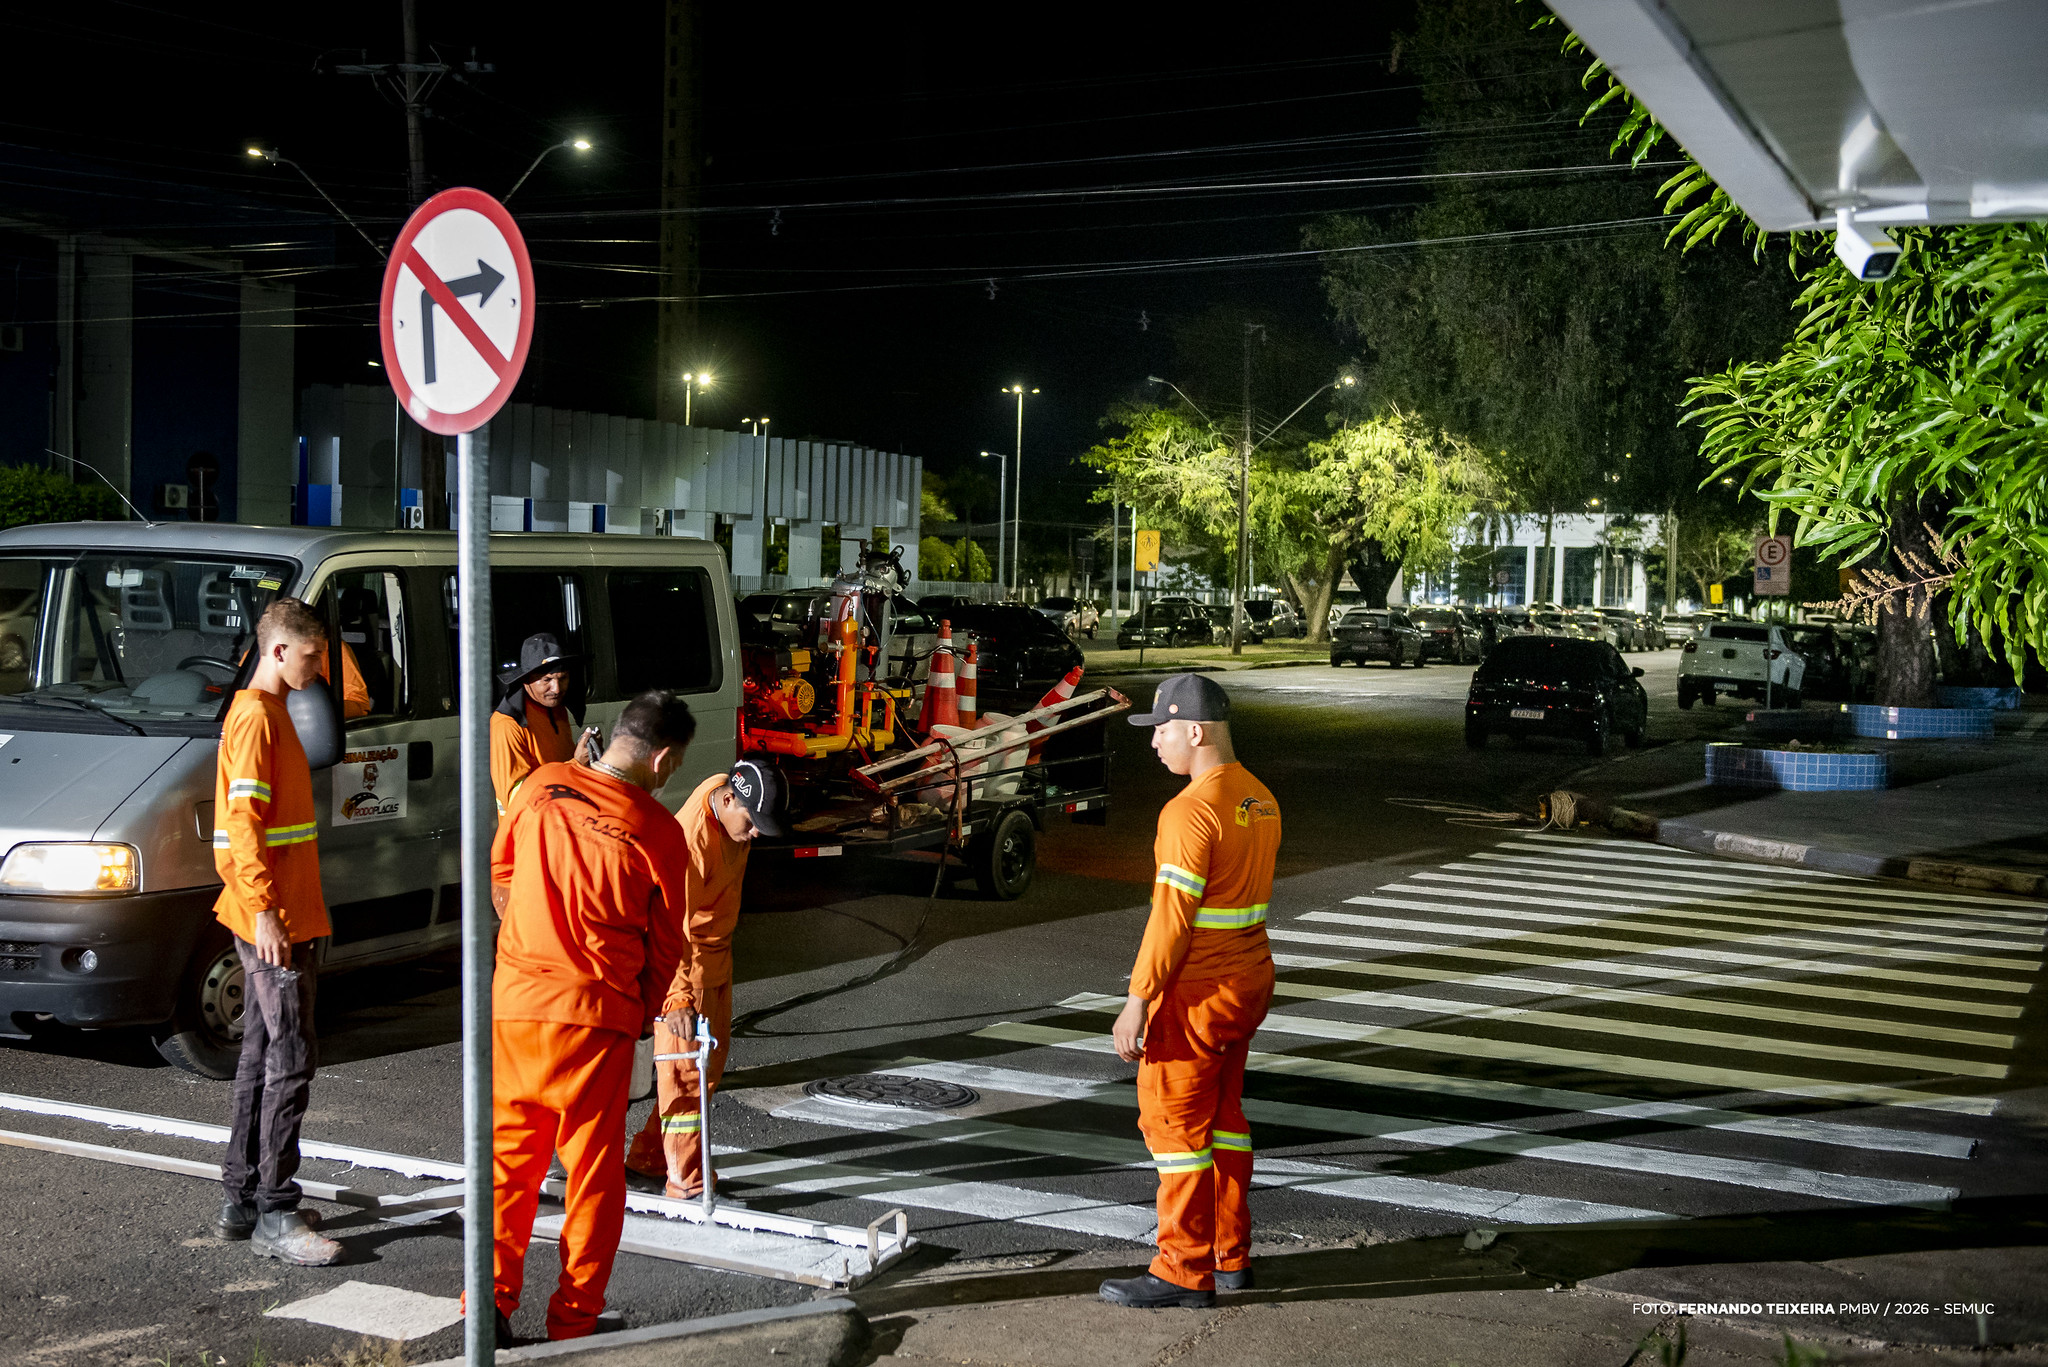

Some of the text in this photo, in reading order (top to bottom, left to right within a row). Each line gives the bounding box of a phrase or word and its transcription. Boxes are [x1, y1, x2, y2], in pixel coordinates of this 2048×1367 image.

[1768, 545, 1777, 559] E
[343, 746, 398, 764] SINALIZAÇÃO
[731, 771, 752, 798] FILA
[354, 803, 400, 816] RODOPLACAS
